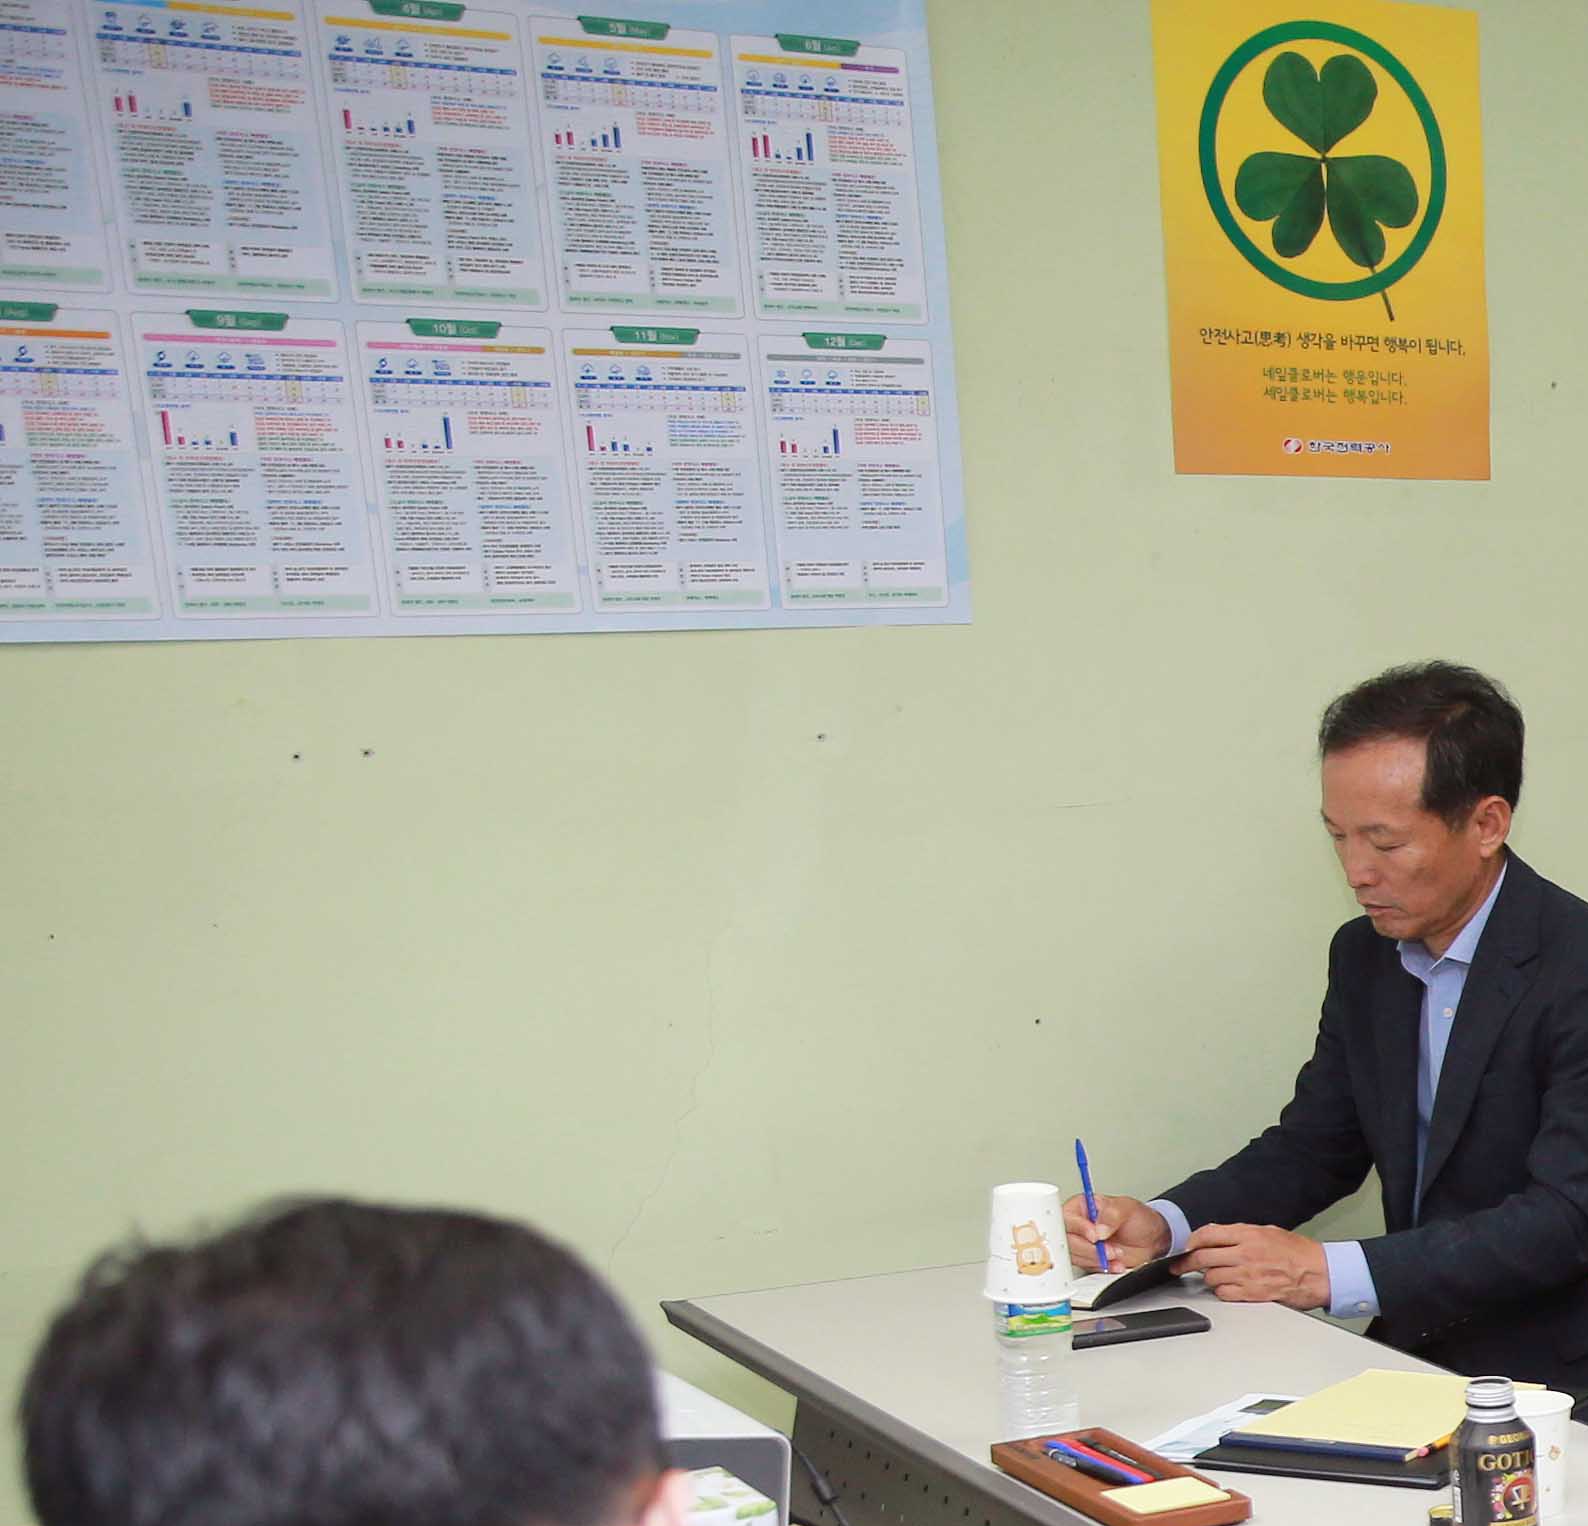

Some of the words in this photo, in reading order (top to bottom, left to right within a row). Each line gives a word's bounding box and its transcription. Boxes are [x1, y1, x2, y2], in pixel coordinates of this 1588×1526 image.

[1199, 327, 1292, 349] 안전사고(思考)
[1296, 331, 1336, 351] 생각을
[1340, 335, 1380, 353] 바꾸면
[1384, 337, 1422, 354] 행복이
[1425, 338, 1466, 357] 됩니다.
